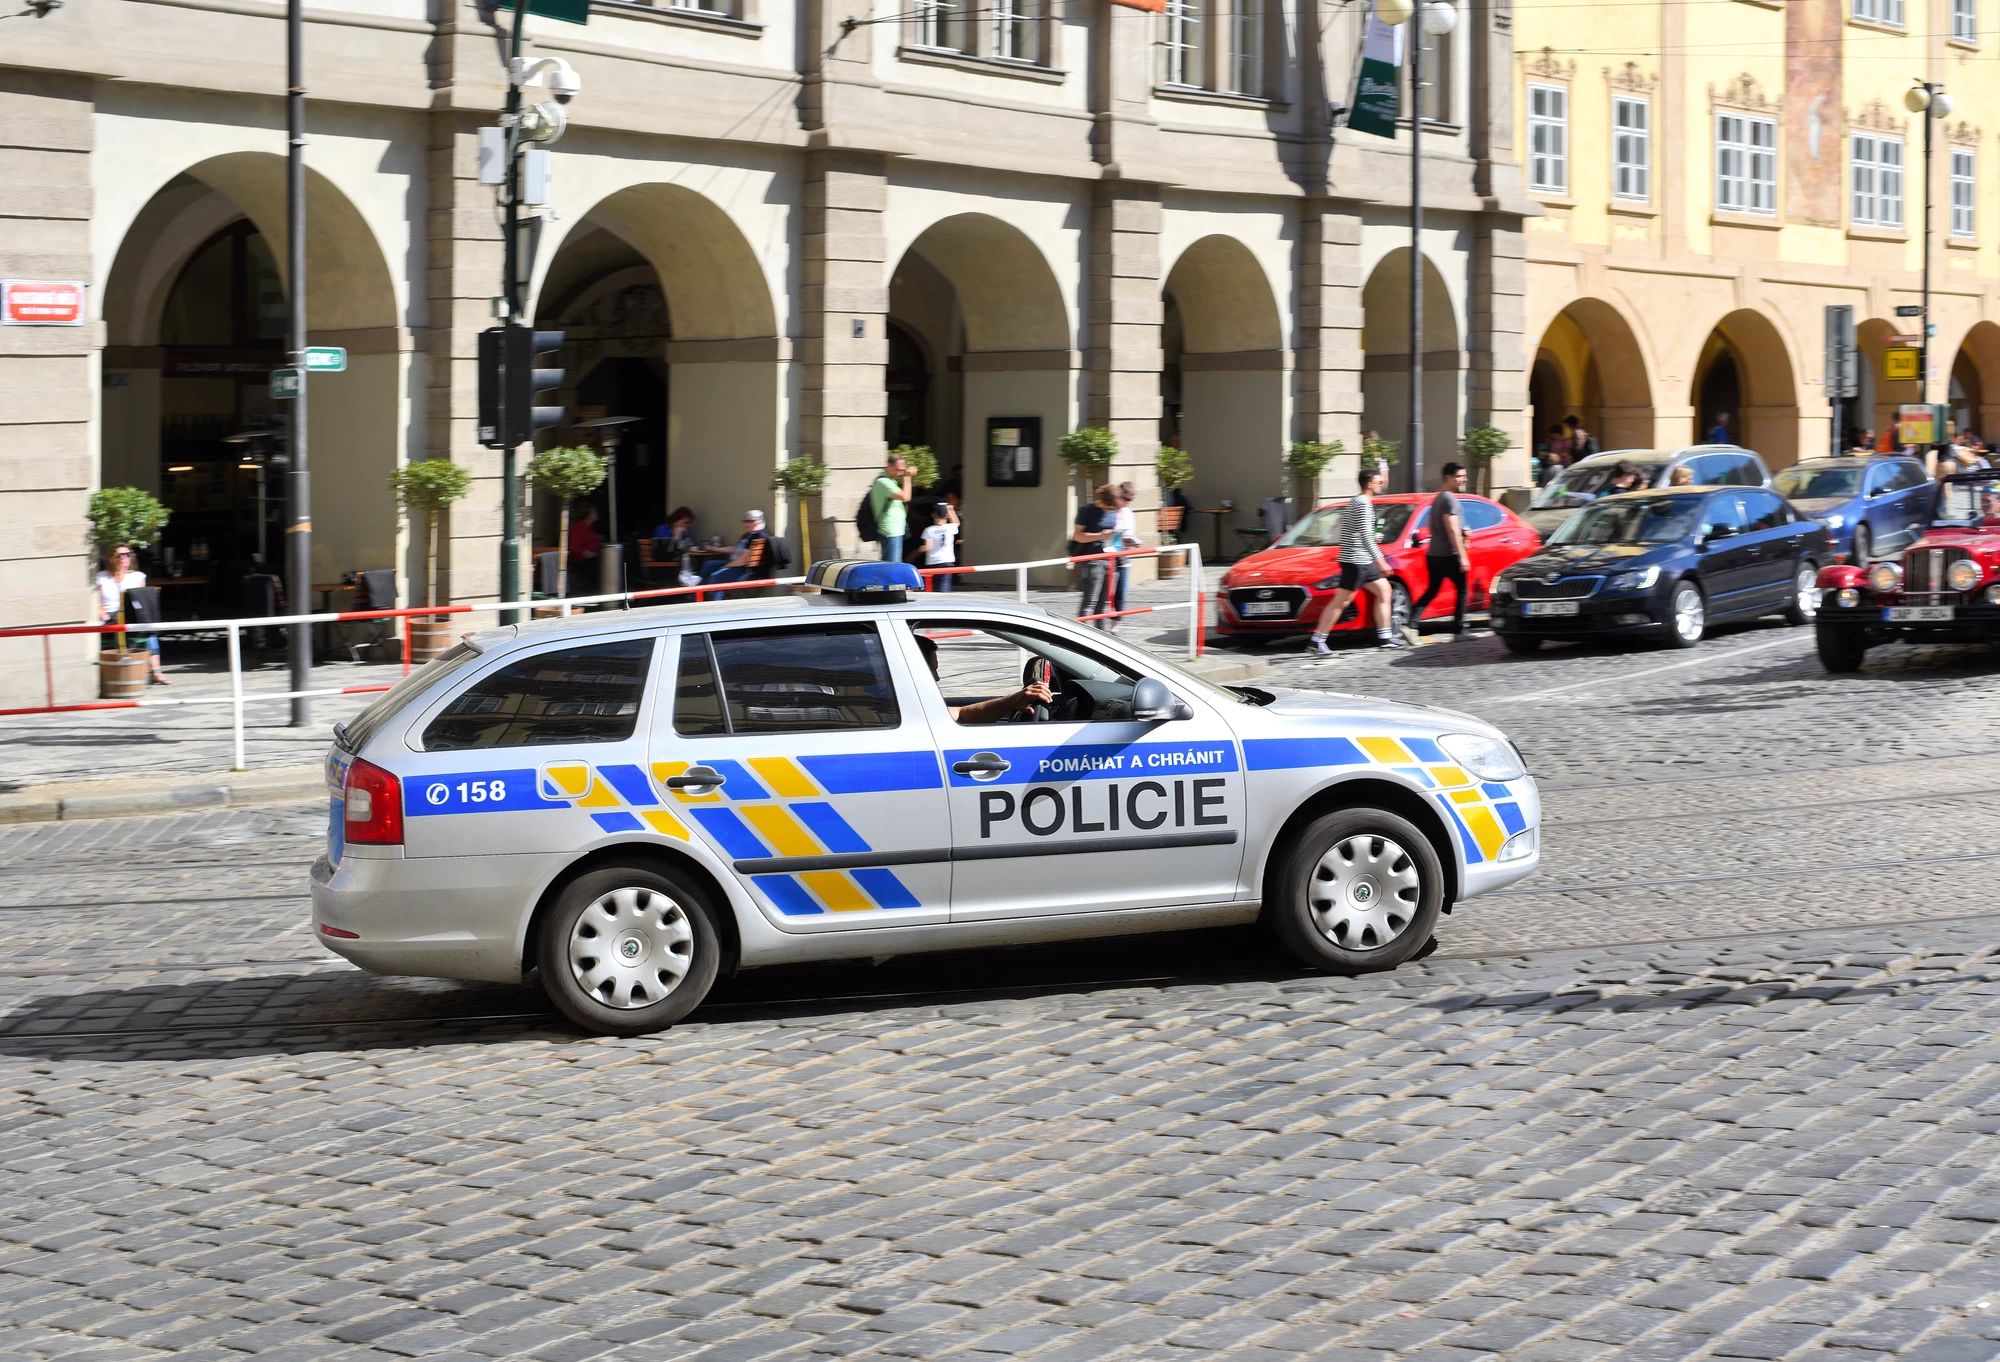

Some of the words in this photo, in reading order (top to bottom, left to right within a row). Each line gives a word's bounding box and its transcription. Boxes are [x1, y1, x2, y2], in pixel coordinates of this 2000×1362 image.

[1039, 754, 1125, 773] POMÁHAT
[1130, 754, 1143, 769] A
[1147, 748, 1225, 767] CHRÁNIT
[456, 780, 507, 803] 158
[979, 777, 1228, 839] POLICIE
